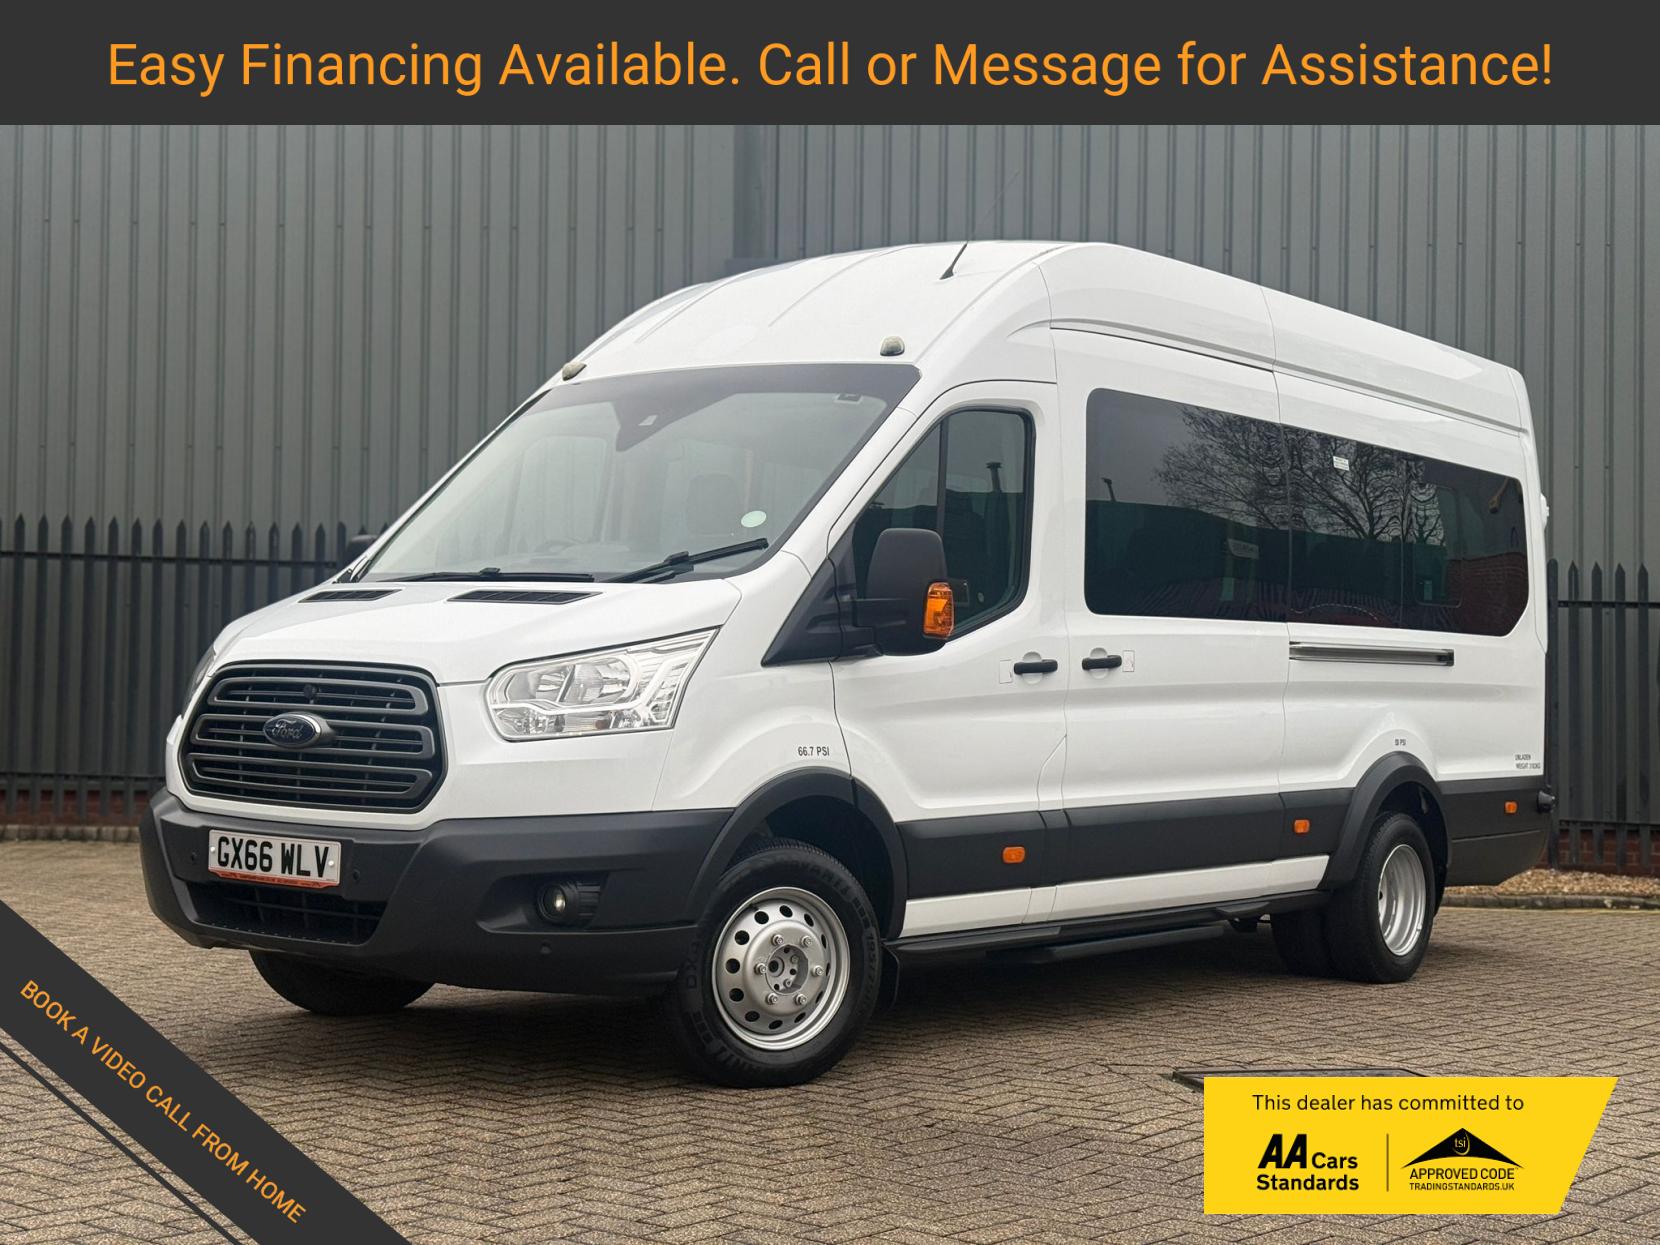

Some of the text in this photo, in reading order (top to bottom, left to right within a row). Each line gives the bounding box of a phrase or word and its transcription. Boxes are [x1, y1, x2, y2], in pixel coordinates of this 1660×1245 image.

[797, 746, 830, 757] 66.7 PSI
[217, 835, 329, 878] GX66 WLV
